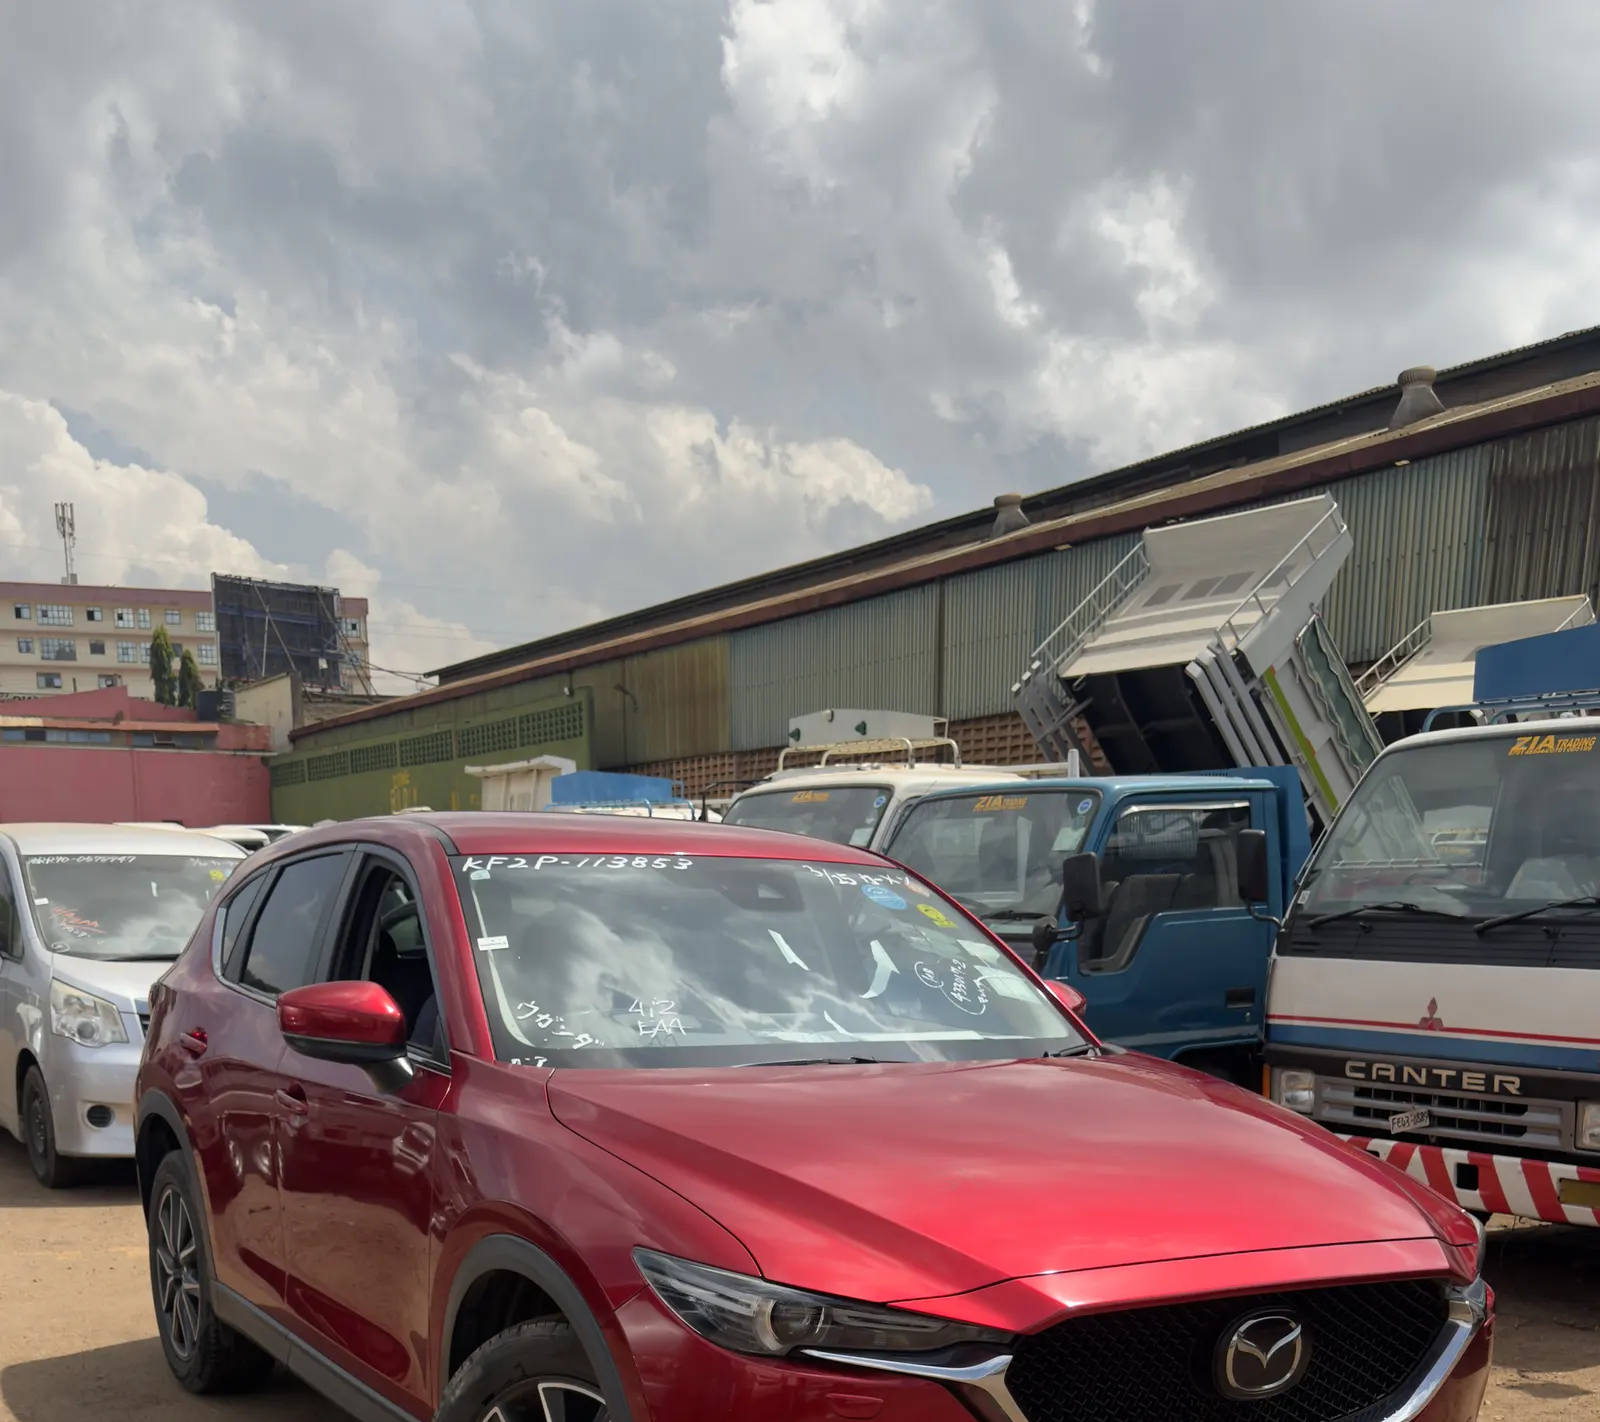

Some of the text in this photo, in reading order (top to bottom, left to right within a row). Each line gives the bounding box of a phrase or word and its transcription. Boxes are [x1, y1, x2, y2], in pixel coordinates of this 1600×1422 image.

[1510, 734, 1555, 754] ZIA
[1555, 736, 1597, 751] TRADING
[974, 794, 1004, 812] ZIA
[462, 855, 693, 872] KF2P-113853
[1344, 1060, 1523, 1096] CANTER
